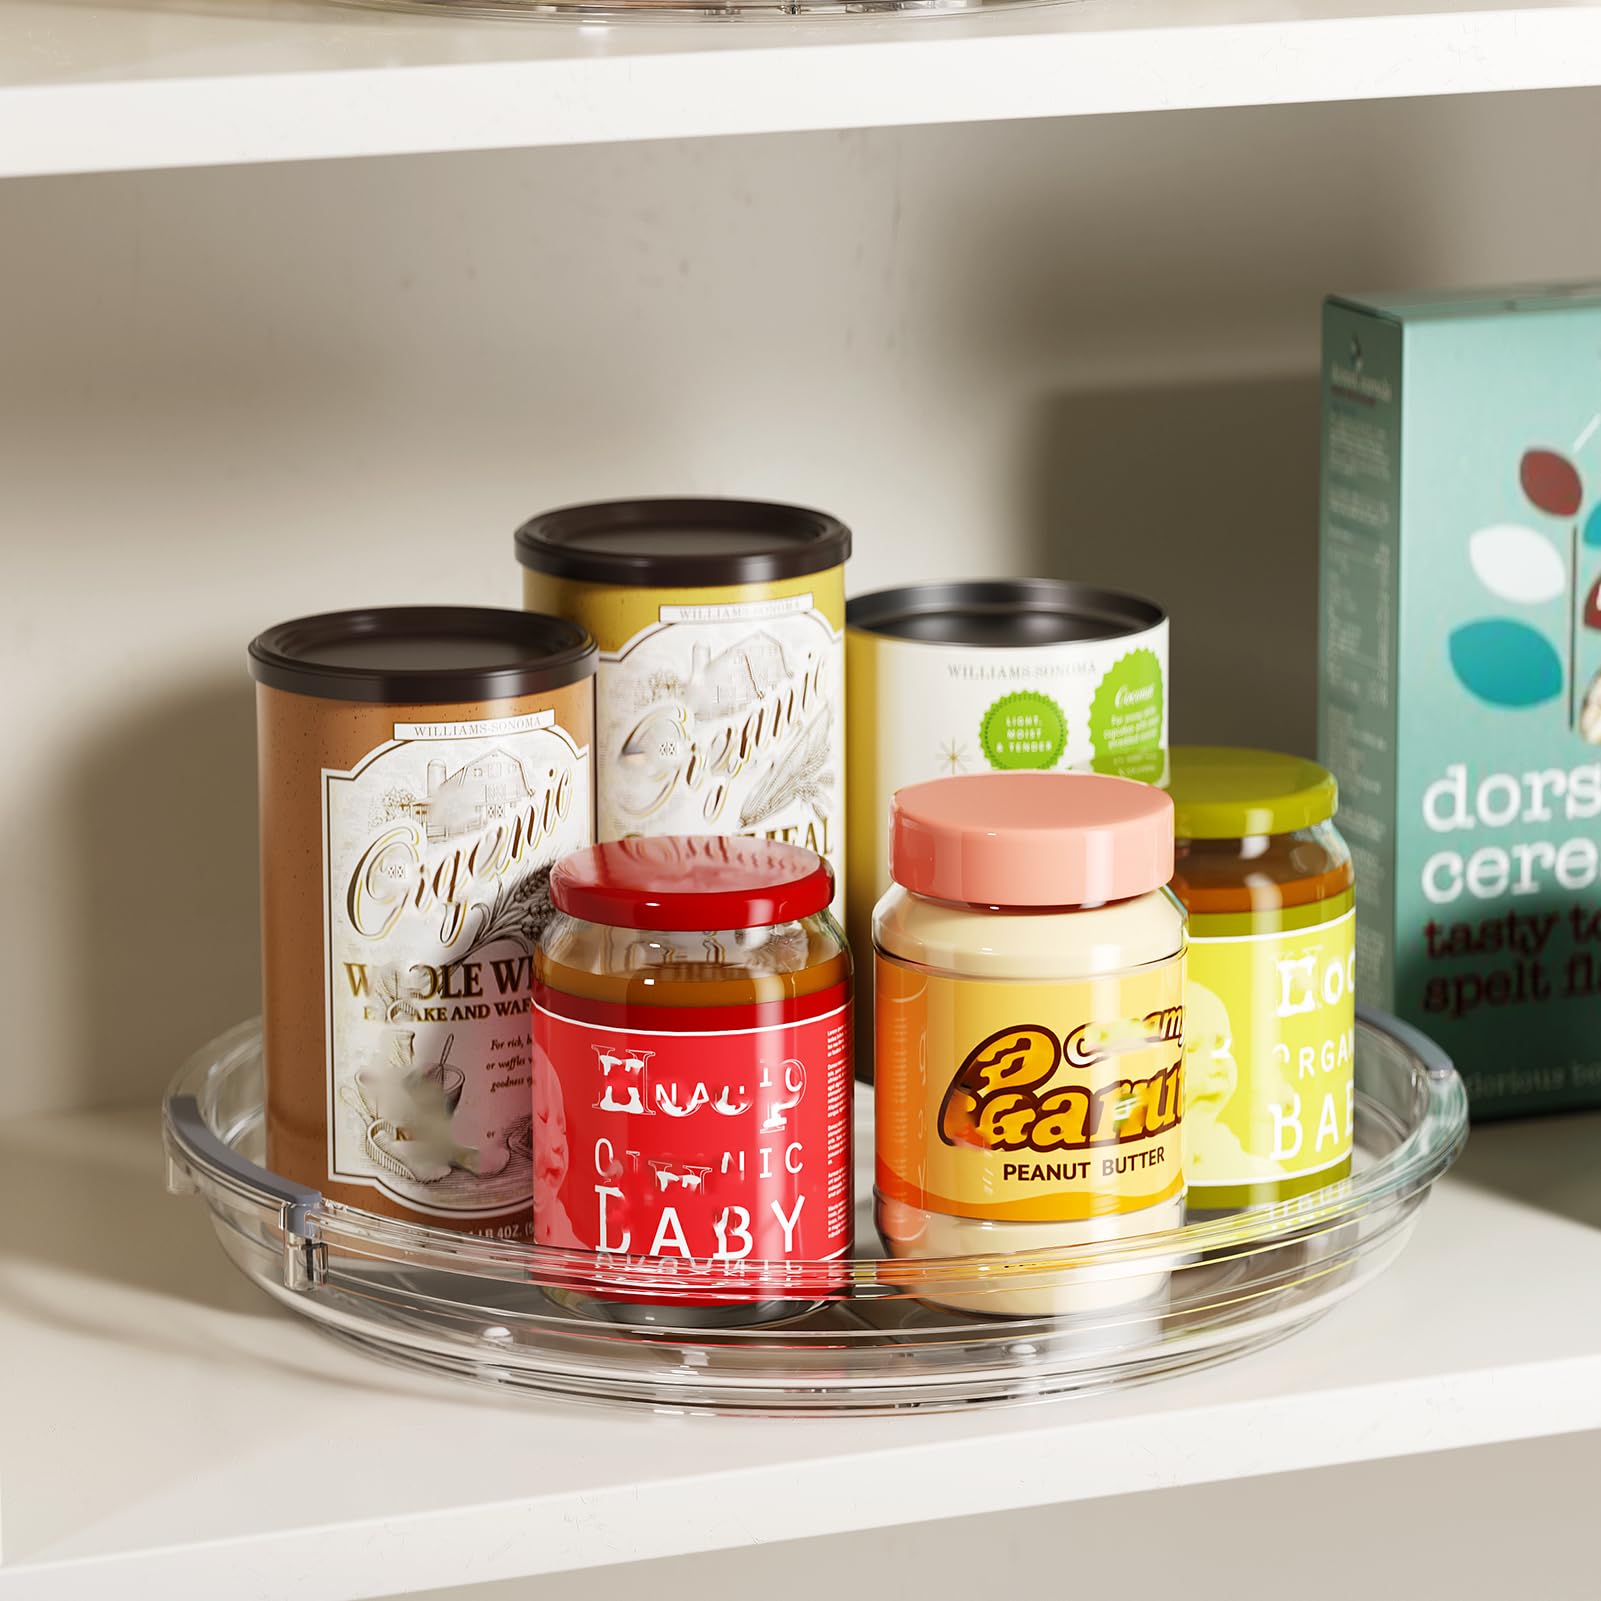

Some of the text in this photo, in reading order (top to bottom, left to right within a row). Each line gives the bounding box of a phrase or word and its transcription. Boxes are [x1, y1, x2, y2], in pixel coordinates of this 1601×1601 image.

[451, 1003, 491, 1021] AND
[1003, 1146, 1165, 1182] PEANUT BUTTER
